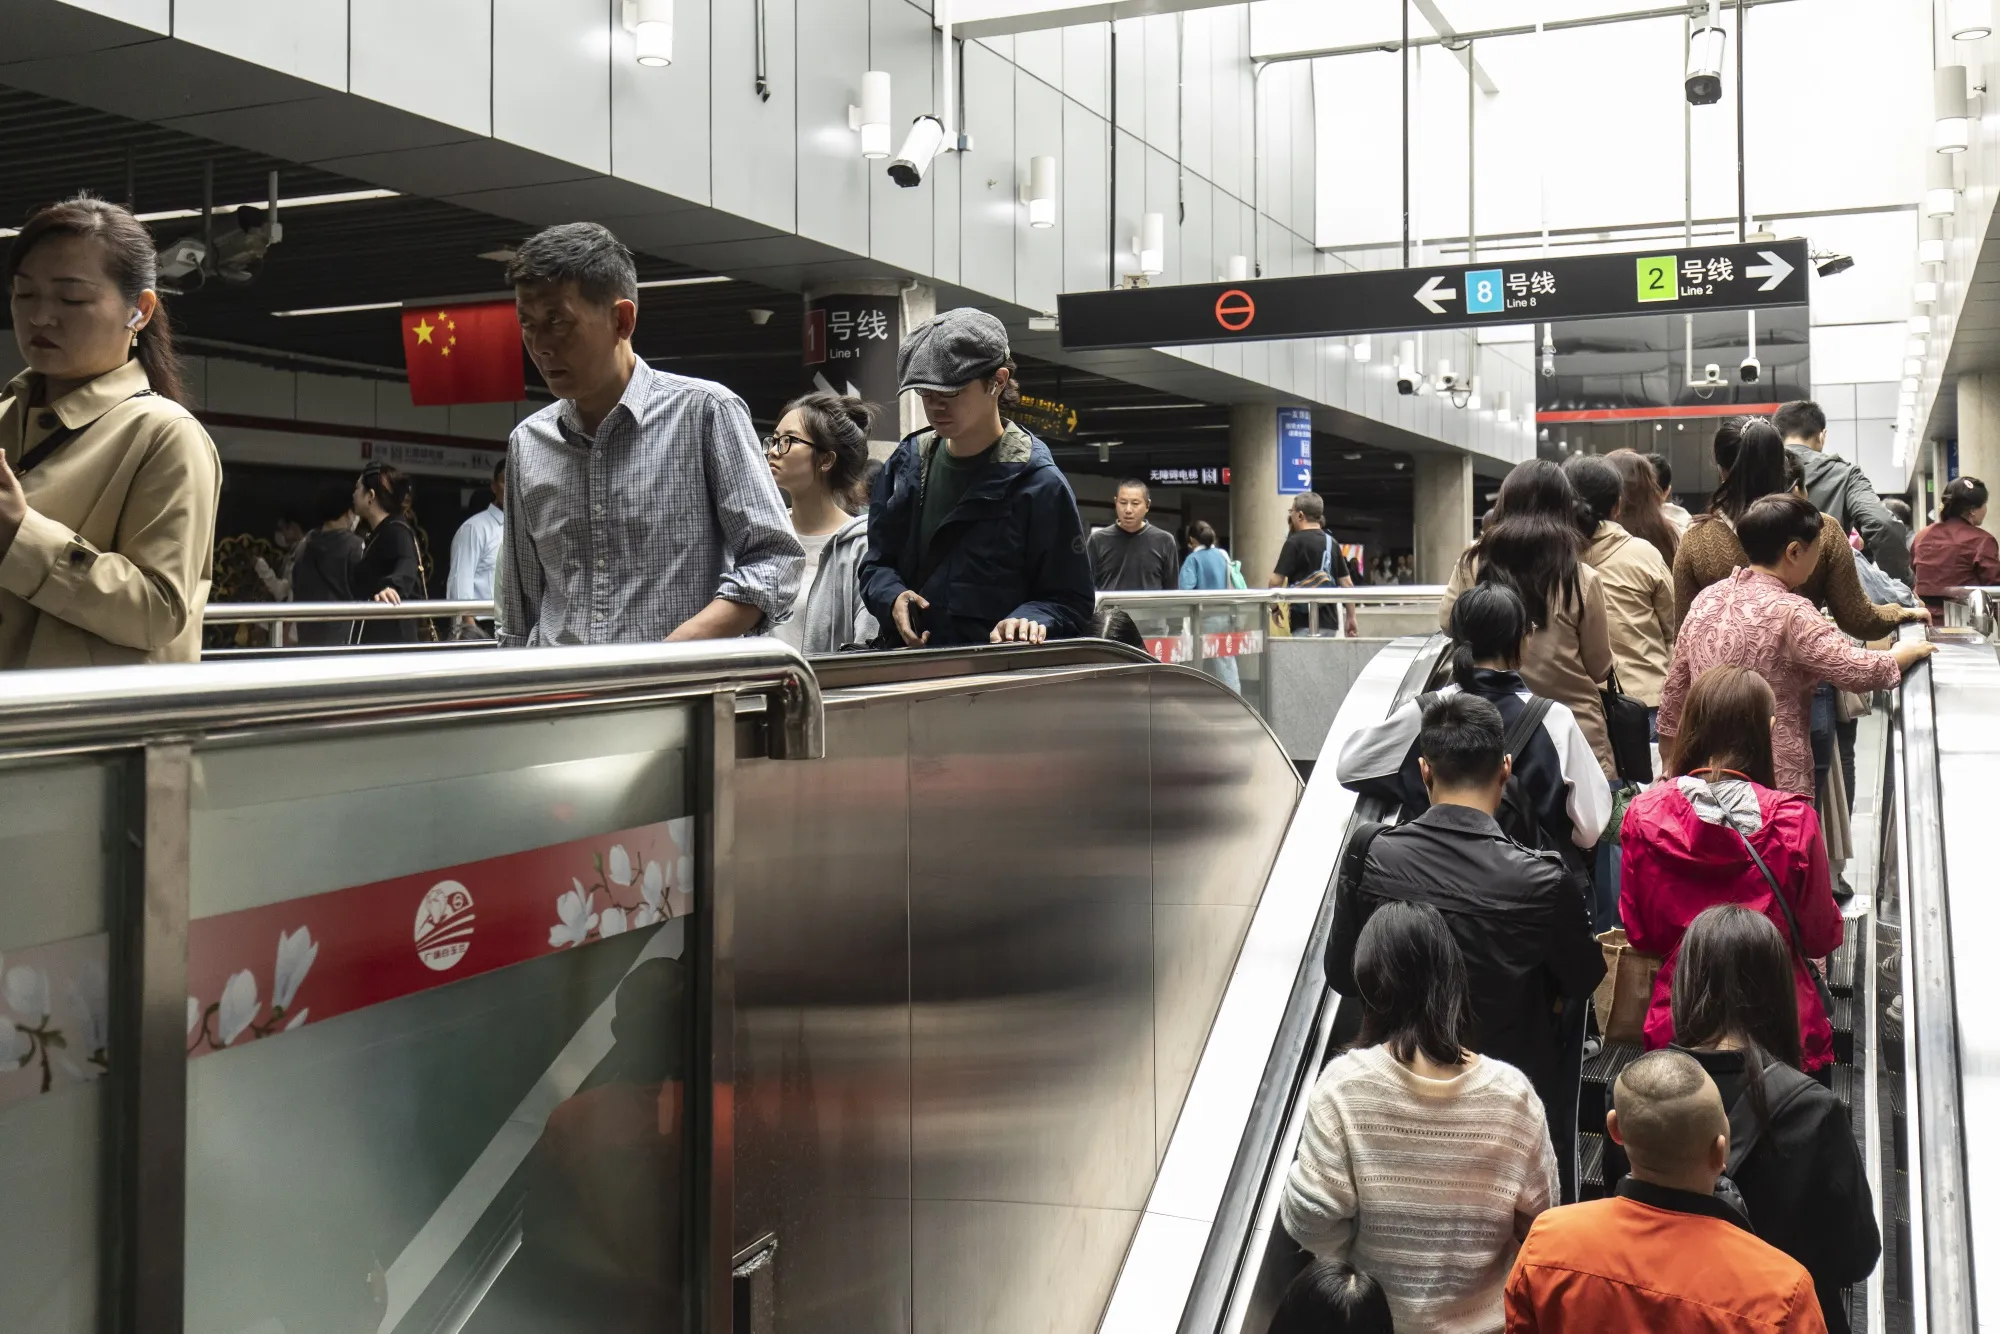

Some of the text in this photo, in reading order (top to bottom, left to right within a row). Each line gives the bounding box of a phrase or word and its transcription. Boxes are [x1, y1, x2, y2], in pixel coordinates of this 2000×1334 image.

[1648, 257, 1735, 291] 2 号线
[1477, 270, 1557, 304] 8 号线
[1680, 284, 1714, 297] Line 2
[1506, 297, 1537, 309] Line 8
[807, 309, 889, 353] 1 号线
[829, 347, 861, 360] Line 1
[1150, 469, 1199, 481] 无障碍电梯
